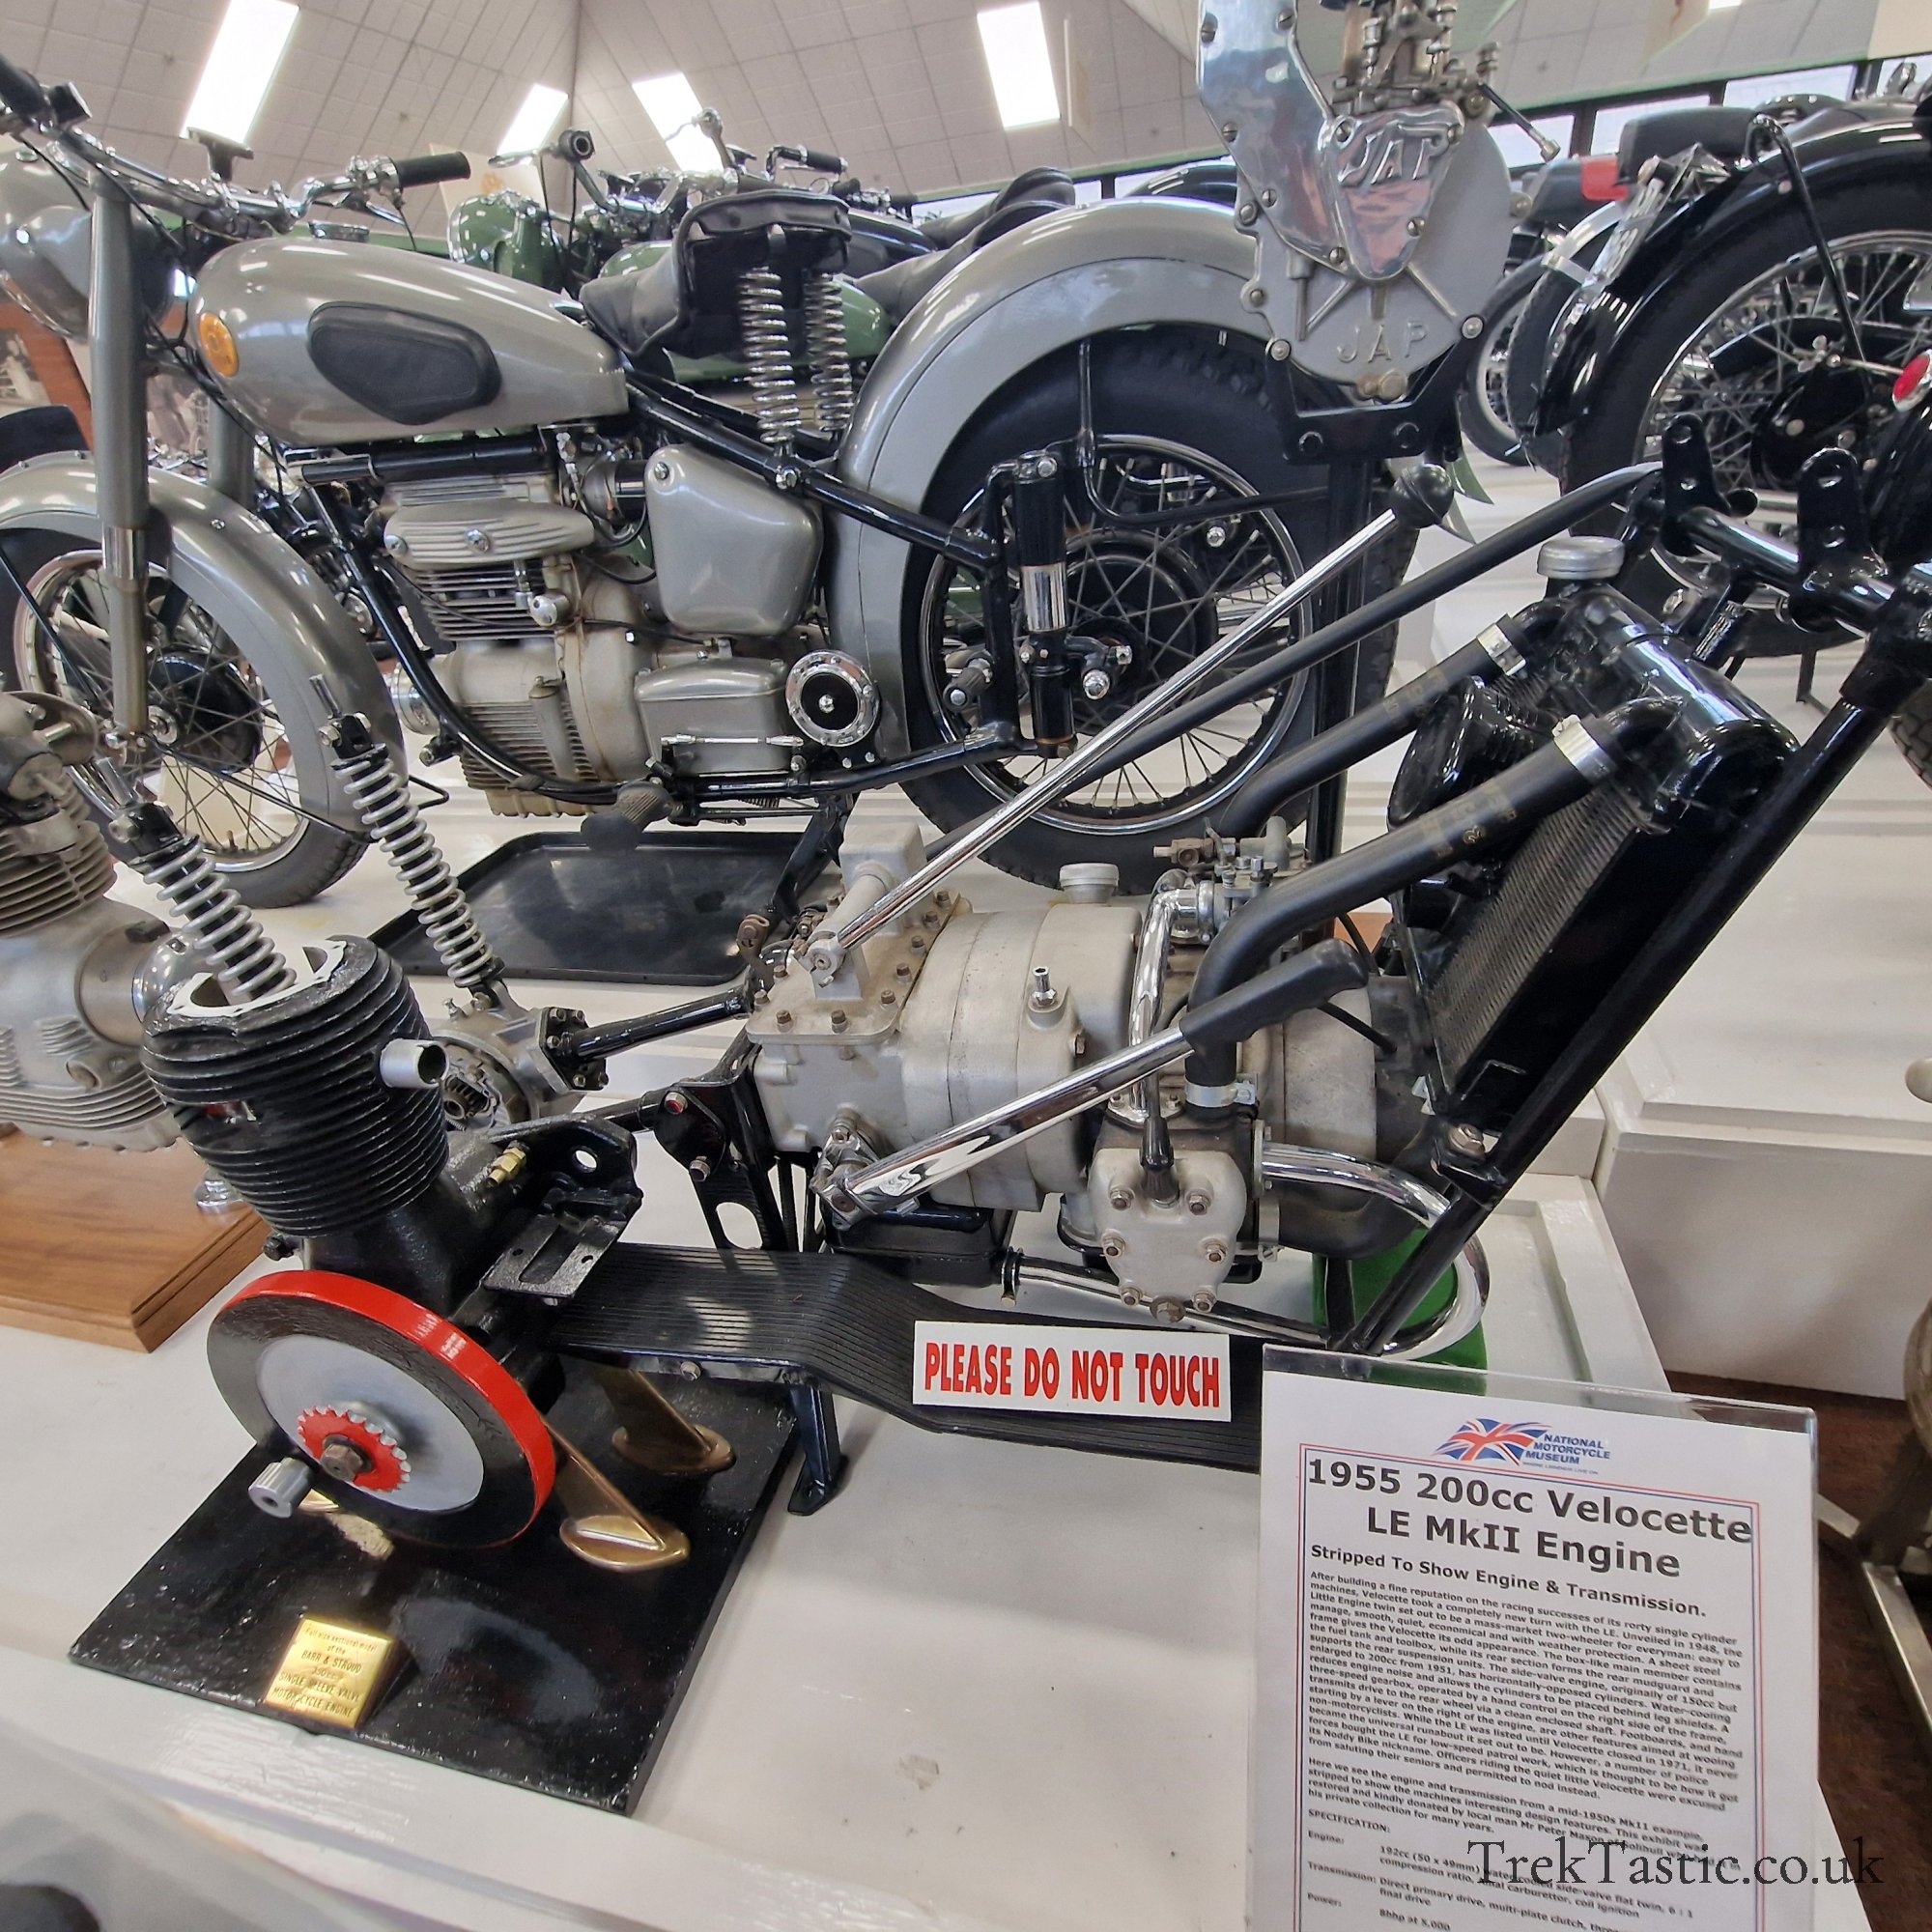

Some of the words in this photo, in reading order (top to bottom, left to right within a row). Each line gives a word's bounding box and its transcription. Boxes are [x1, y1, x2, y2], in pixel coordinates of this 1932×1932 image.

[1337, 121, 1449, 185] JAP
[1336, 322, 1428, 363] JAP
[924, 1342, 1011, 1395] PLEASE
[1024, 1347, 1060, 1400] DO
[1071, 1350, 1123, 1402] NOT
[1134, 1352, 1220, 1407] TOUCH
[1525, 1451, 1579, 1464] MUSEUM
[1534, 1442, 1610, 1459] MOTORCYCLE
[1544, 1434, 1604, 1449] NATIONAL
[1309, 1459, 1401, 1493] 1955
[1417, 1473, 1533, 1513] 200cc
[1548, 1490, 1751, 1544] Velocette
[1368, 1507, 1409, 1537] LE
[1426, 1515, 1520, 1553] MkII
[1537, 1530, 1680, 1577] Engine
[1310, 1571, 1334, 1581] After
[1337, 1575, 1376, 1590] building
[1388, 1582, 1406, 1593] fine
[1409, 1588, 1463, 1602] reputation
[1481, 1598, 1498, 1607] the
[1501, 1602, 1534, 1614] racing
[1537, 1607, 1590, 1622] successes
[1607, 1617, 1621, 1627] its
[1624, 1622, 1651, 1633] rorty
[1655, 1626, 1688, 1637] single
[1690, 1633, 1737, 1644] cylinder
[1311, 1544, 1384, 1567] Stripped
[1391, 1555, 1412, 1571] To
[1419, 1560, 1468, 1579] Show
[1476, 1569, 1539, 1591] Engine
[1546, 1579, 1559, 1594] &
[1566, 1582, 1706, 1616] Transmission.
[1310, 1582, 1358, 1597] machines,
[1362, 1589, 1408, 1604] Velocette
[1410, 1598, 1434, 1607] took
[1445, 1605, 1501, 1620] completely
[1504, 1613, 1526, 1622] new
[1529, 1616, 1551, 1626] turn
[1555, 1622, 1578, 1631] with
[1581, 1625, 1600, 1634] the
[1603, 1628, 1618, 1637] LE.
[1622, 1631, 1670, 1645] Unveiled
[1674, 1639, 1684, 1648] in
[1723, 1647, 1742, 1657] the
[1310, 1591, 1335, 1603] Little
[1338, 1596, 1370, 1608] Engine
[1373, 1602, 1395, 1611] twin
[1435, 1611, 1446, 1620] to
[1449, 1613, 1462, 1623] be
[1474, 1619, 1542, 1635] mass-market
[1546, 1630, 1613, 1647] two-wheeler
[1616, 1640, 1632, 1650] for
[1698, 1656, 1723, 1666] easy
[1310, 1603, 1350, 1616] manage,
[1354, 1610, 1393, 1623] smooth,
[1397, 1617, 1425, 1628] quiet,
[1428, 1623, 1486, 1636] economical
[1537, 1640, 1581, 1652] weather
[1584, 1648, 1644, 1663] protection.
[1648, 1657, 1656, 1665] A
[1659, 1660, 1690, 1670] sheet
[1692, 1665, 1719, 1675] steel
[1310, 1611, 1338, 1623] frame
[1341, 1618, 1366, 1628] gives
[1369, 1622, 1385, 1632] the
[1388, 1625, 1435, 1639] Velocette
[1438, 1634, 1451, 1642] its
[1454, 1636, 1472, 1646] odd
[1476, 1640, 1539, 1657] appearance.
[1544, 1650, 1562, 1660] The
[1565, 1654, 1609, 1668] box-like
[1612, 1663, 1639, 1673] main
[1643, 1668, 1689, 1681] member
[1692, 1677, 1741, 1690] contains
[301, 1649, 321, 1662] BARR
[323, 1656, 329, 1664] &
[332, 1657, 362, 1673] STROUD
[308, 1677, 336, 1694] LEEVE
[1308, 1736, 1331, 1747] from
[1334, 1743, 1374, 1756] saluting
[1377, 1749, 1400, 1760] their
[1403, 1756, 1440, 1768] seniors
[1443, 1763, 1462, 1773] and
[1465, 1768, 1517, 1782] permitted
[1520, 1776, 1531, 1785] to
[1534, 1780, 1553, 1790] nod
[1403, 1712, 1432, 1723] While
[1435, 1718, 1451, 1727] the
[1455, 1720, 1465, 1730] LE
[1469, 1725, 1490, 1734] was
[1493, 1728, 1521, 1740] listed
[1525, 1735, 1549, 1745] until
[1552, 1739, 1604, 1754] Velocette
[1606, 1749, 1641, 1762] closed
[1308, 1756, 1331, 1768] Here
[1334, 1763, 1349, 1772] we
[1351, 1767, 1368, 1776] see
[1371, 1770, 1387, 1779] the
[1390, 1775, 1424, 1786] engine
[1427, 1781, 1446, 1791] and
[1449, 1784, 1517, 1804] transmission
[1520, 1798, 1545, 1810] from
[1557, 1806, 1615, 1824] mid-1950s
[1308, 1788, 1322, 1798] his
[1325, 1793, 1360, 1805] private
[1362, 1801, 1410, 1816] collection
[1413, 1809, 1428, 1819] for
[1432, 1814, 1460, 1827] many
